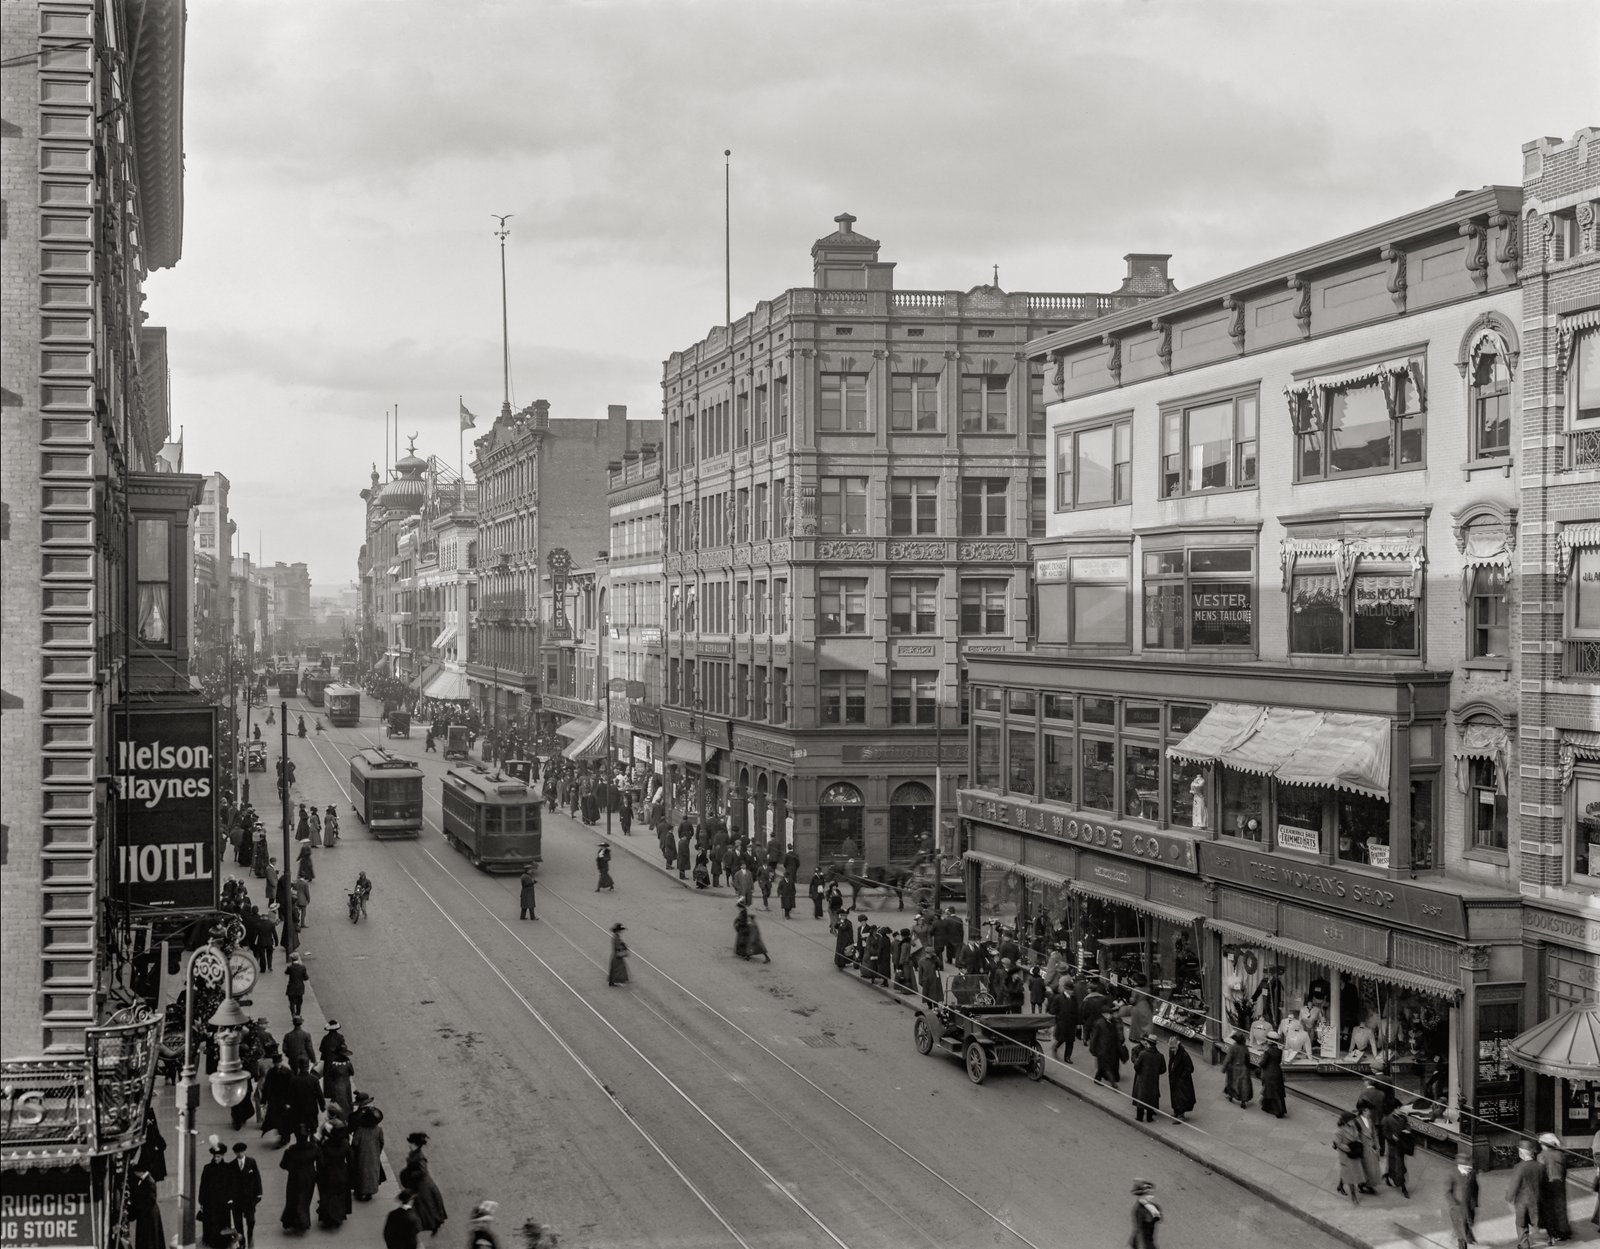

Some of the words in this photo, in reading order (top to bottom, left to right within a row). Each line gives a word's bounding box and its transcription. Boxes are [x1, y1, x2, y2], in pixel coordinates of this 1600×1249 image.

[555, 583, 563, 627] LYNCH
[1194, 594, 1247, 607] VESTER
[1358, 604, 1411, 617] MILLINERY
[1195, 610, 1217, 621] MENS
[1219, 610, 1248, 621] TAILOR
[1299, 613, 1340, 627] MILLINERY
[120, 775, 211, 808] Haynes
[976, 800, 1009, 823] THE
[1052, 816, 1123, 850] WOODS
[1281, 832, 1302, 845] TRIMMED
[118, 842, 212, 883] HOTEL
[1250, 861, 1279, 883] THE
[1282, 868, 1346, 898] WOMAN'S
[1353, 885, 1395, 910] SHOP
[1421, 903, 1443, 918] 387
[1526, 912, 1586, 940] BOOKSTORE
[24, 1220, 78, 1239] STORE
